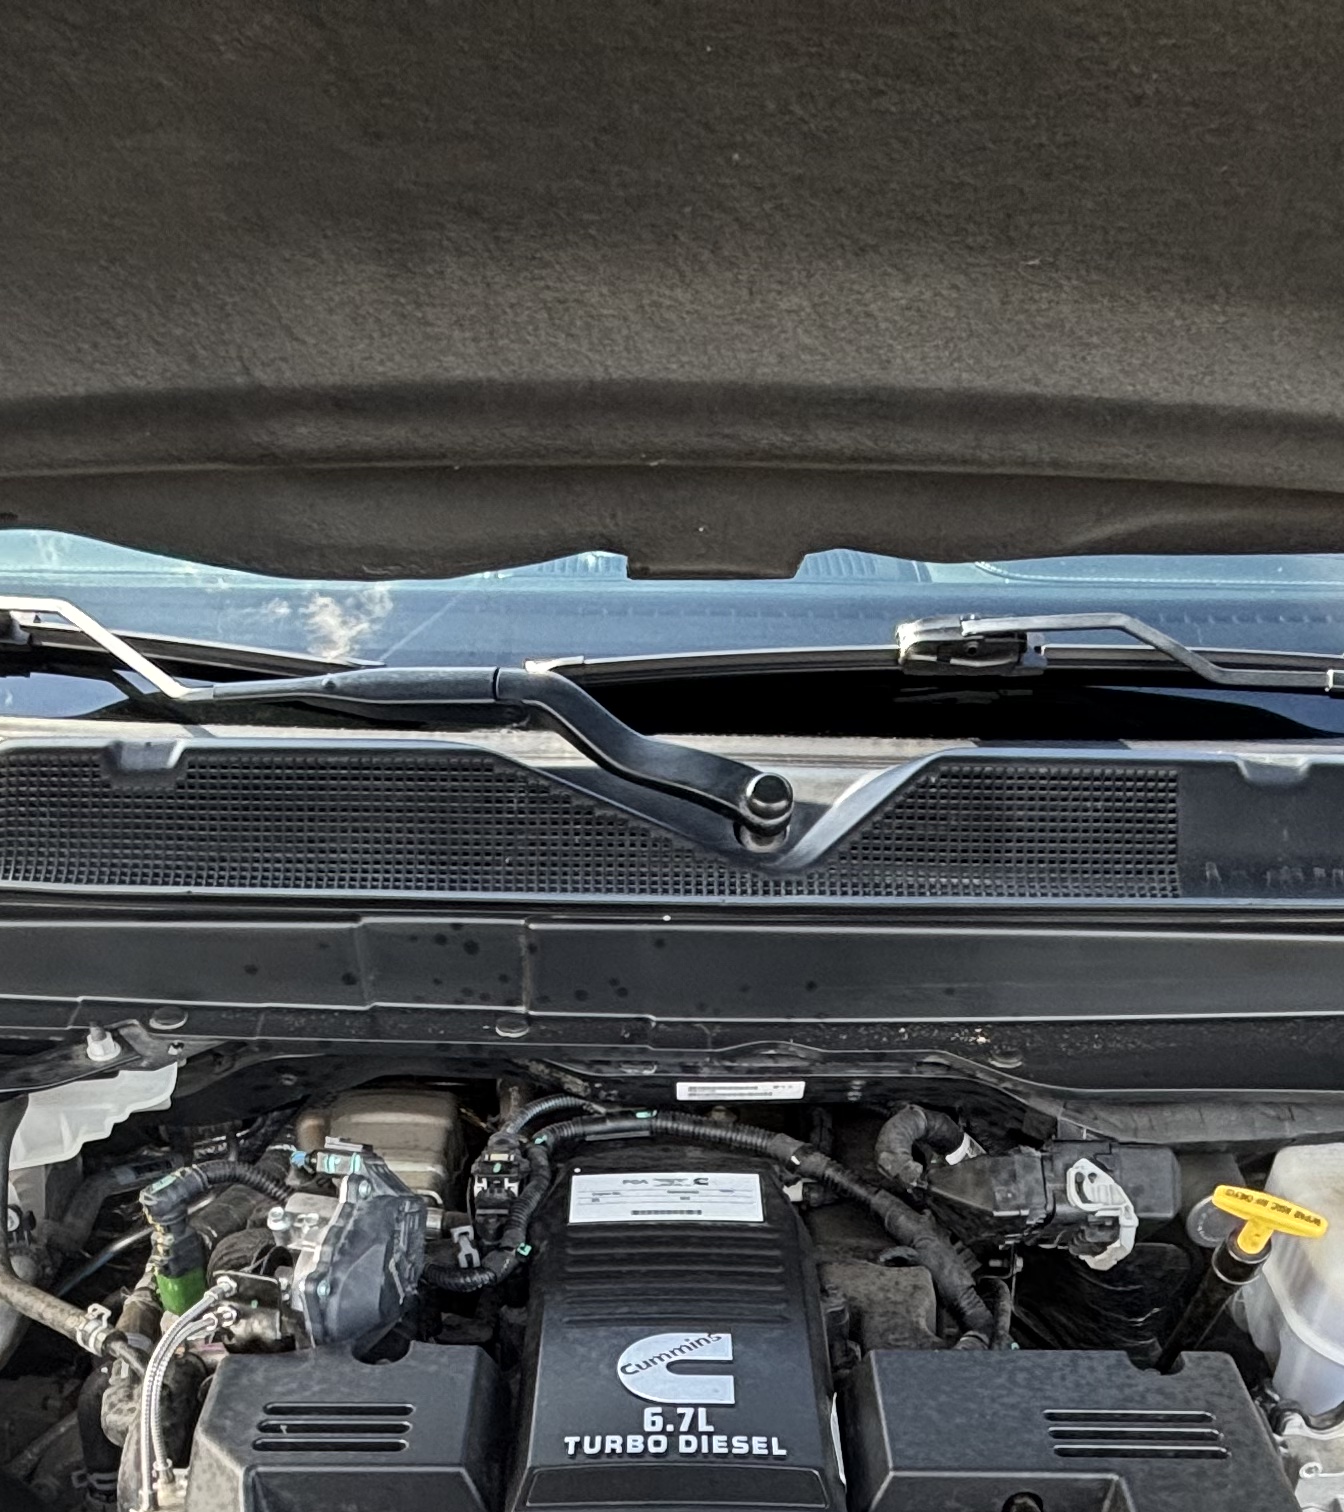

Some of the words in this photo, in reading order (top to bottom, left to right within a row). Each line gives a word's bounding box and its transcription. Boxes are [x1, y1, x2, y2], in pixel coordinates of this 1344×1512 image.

[620, 1333, 722, 1375] Cummins
[643, 1406, 715, 1432] 6.7L
[564, 1434, 669, 1455] TURBO
[678, 1434, 787, 1456] DIESEL
